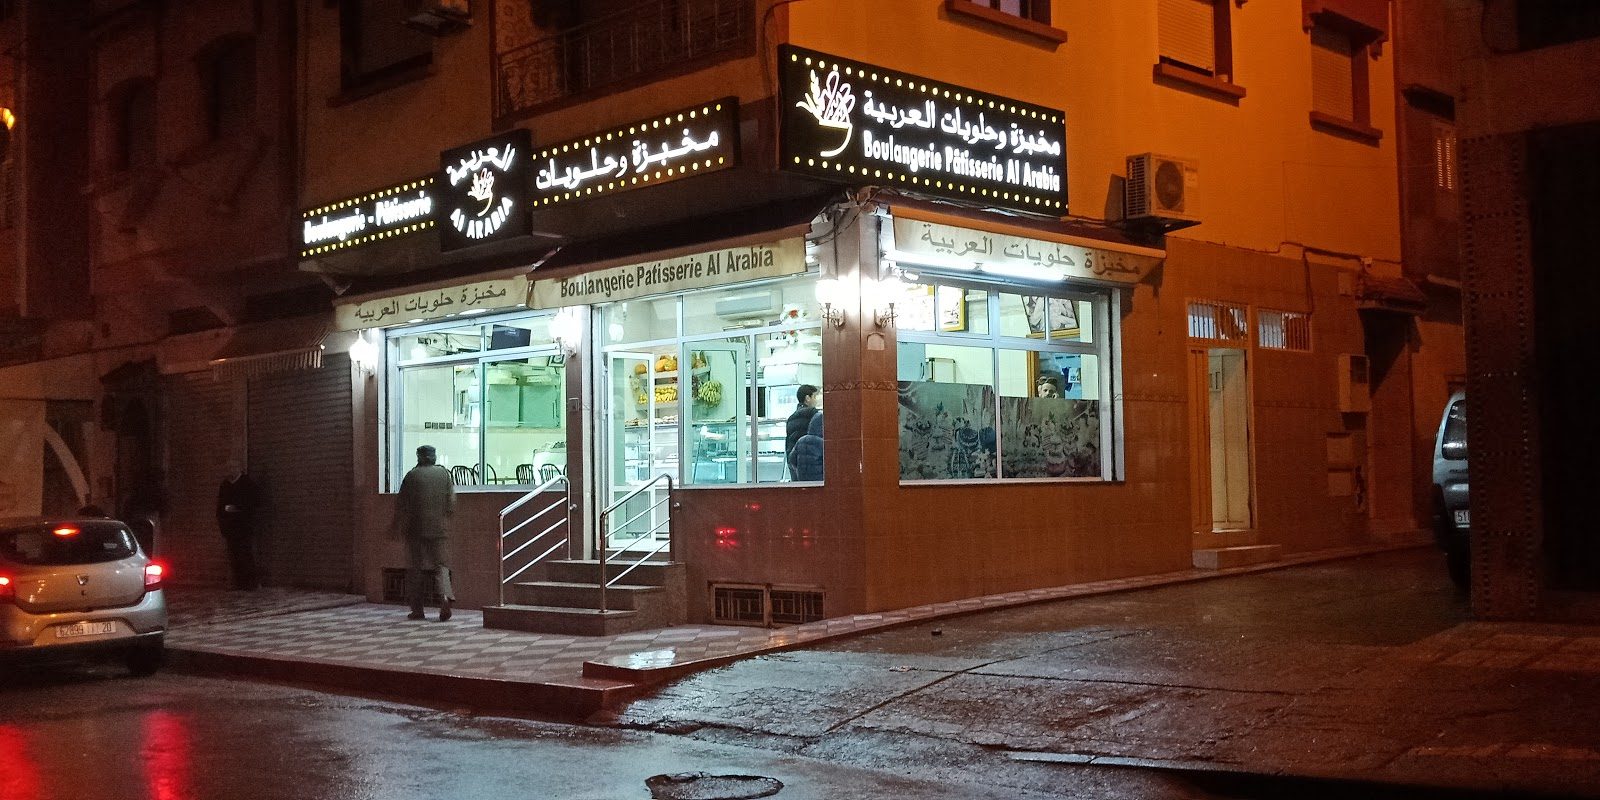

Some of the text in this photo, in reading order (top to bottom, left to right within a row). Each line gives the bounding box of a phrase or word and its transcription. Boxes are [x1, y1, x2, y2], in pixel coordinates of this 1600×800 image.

[863, 89, 1061, 156] مخبزة وحلويات العربية
[446, 142, 516, 187] العربية
[632, 128, 719, 174] مخبزة
[863, 129, 1061, 192] Boulangerie Pâtisserie Al Arabia
[304, 207, 366, 244] Boulangerie
[466, 196, 514, 240] ARABIA
[560, 245, 774, 298] Boulangerie Patisserie Al Arabia
[920, 223, 1140, 276] مخبزة حلويات العربية
[404, 292, 454, 314] حلويات
[460, 284, 507, 306] مخبزة
